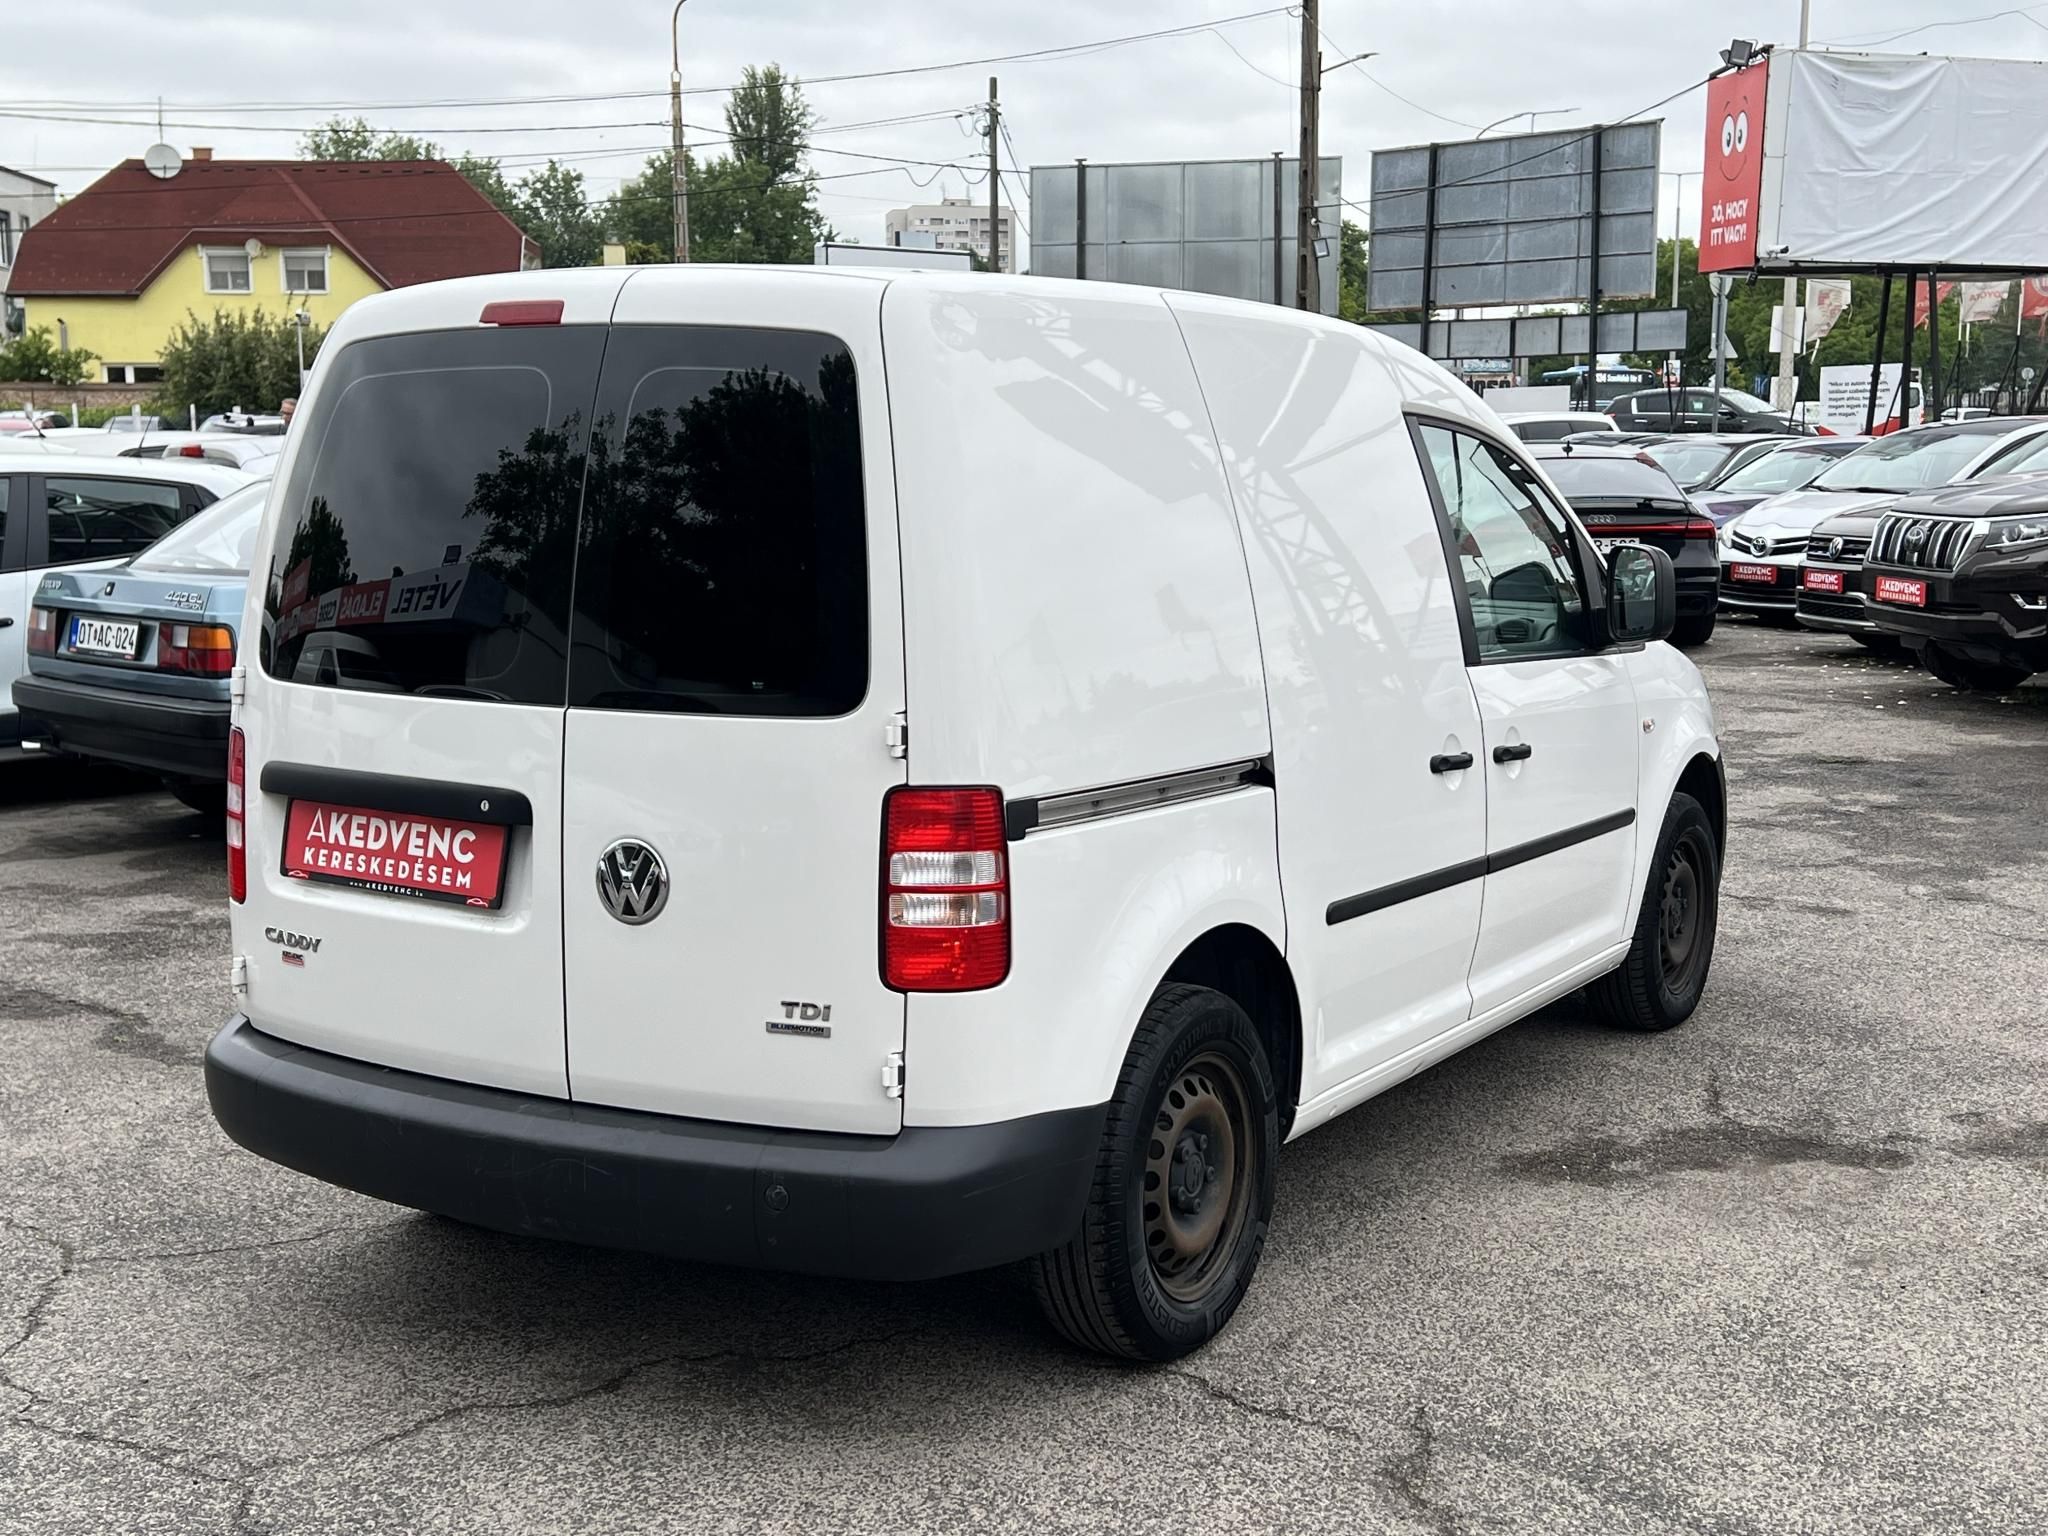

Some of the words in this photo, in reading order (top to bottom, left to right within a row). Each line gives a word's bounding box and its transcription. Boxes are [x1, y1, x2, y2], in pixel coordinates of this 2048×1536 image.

[1711, 200, 1725, 224] JÓ,
[1725, 198, 1749, 220] HOGY
[1710, 227, 1723, 247] ITT
[1723, 223, 1747, 244] VAGY!
[78, 622, 94, 645] OT
[306, 807, 477, 864] AKEDVENC
[303, 847, 472, 889] KERESKEDÉSEM
[265, 926, 322, 953] CADDY
[781, 1001, 832, 1022] TDI
[770, 1023, 825, 1034] BLUEMOTION
